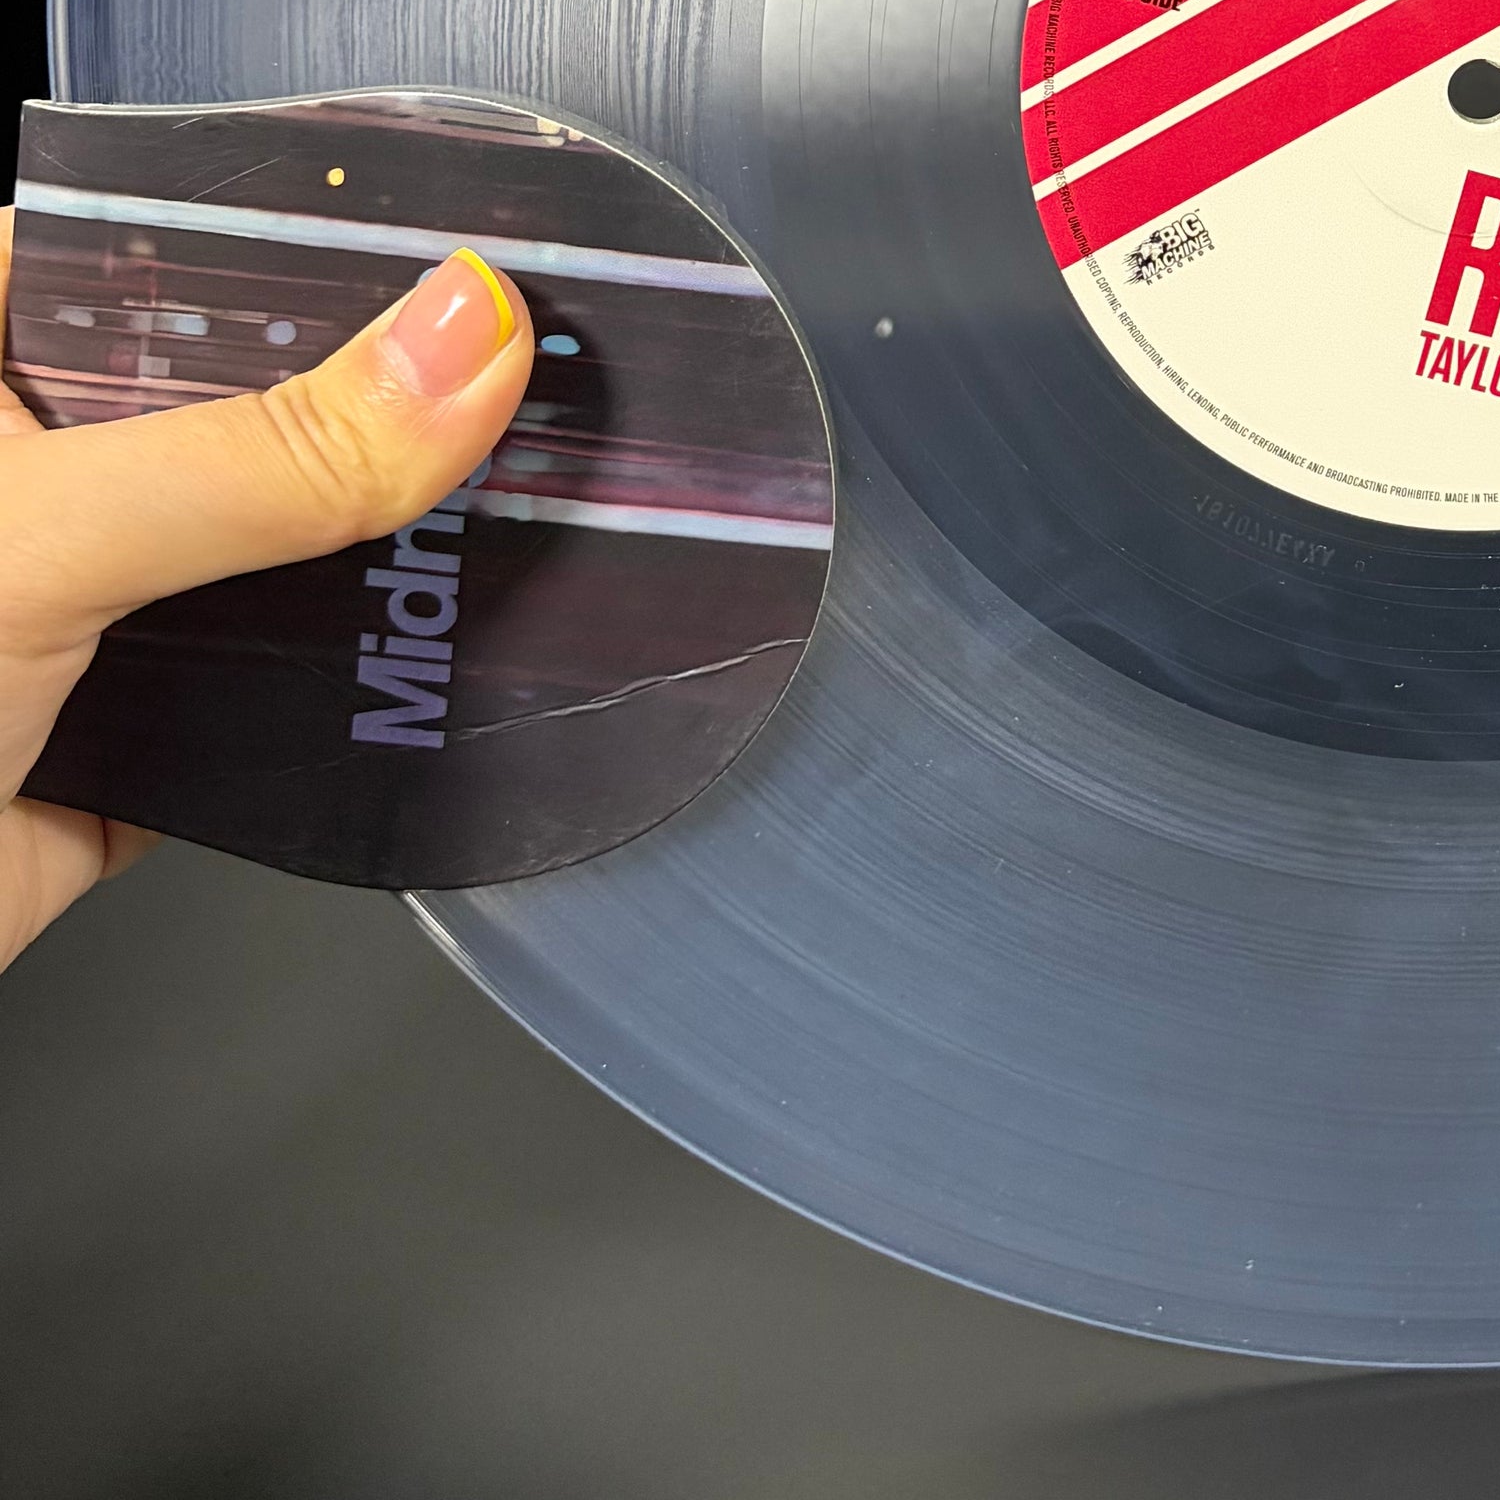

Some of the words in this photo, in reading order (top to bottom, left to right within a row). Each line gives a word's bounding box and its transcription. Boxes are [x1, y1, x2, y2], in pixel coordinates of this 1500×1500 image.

[1044, 12, 1060, 53] MACHINE
[1045, 119, 1057, 135] ALL
[1047, 137, 1063, 169] RIGHTS
[1066, 215, 1102, 278] UNAUTHORISED
[1159, 212, 1206, 250] BIG
[1141, 230, 1212, 280] MACHINE
[1095, 276, 1122, 314] COPYING,
[1117, 311, 1165, 369] REPRODUCTION,
[1161, 364, 1189, 394] HIRING,
[1186, 388, 1221, 420] LENDING,
[1219, 413, 1250, 438] PUBLIC
[1247, 431, 1307, 468] PERFORMANCE
[1306, 461, 1325, 475] AND
[1325, 467, 1389, 494] BROADCASTING
[1389, 485, 1442, 502] PROHIBITED.
[1444, 492, 1469, 503] MADE
[1471, 493, 1481, 503] IN
[1483, 492, 1499, 503] THE
